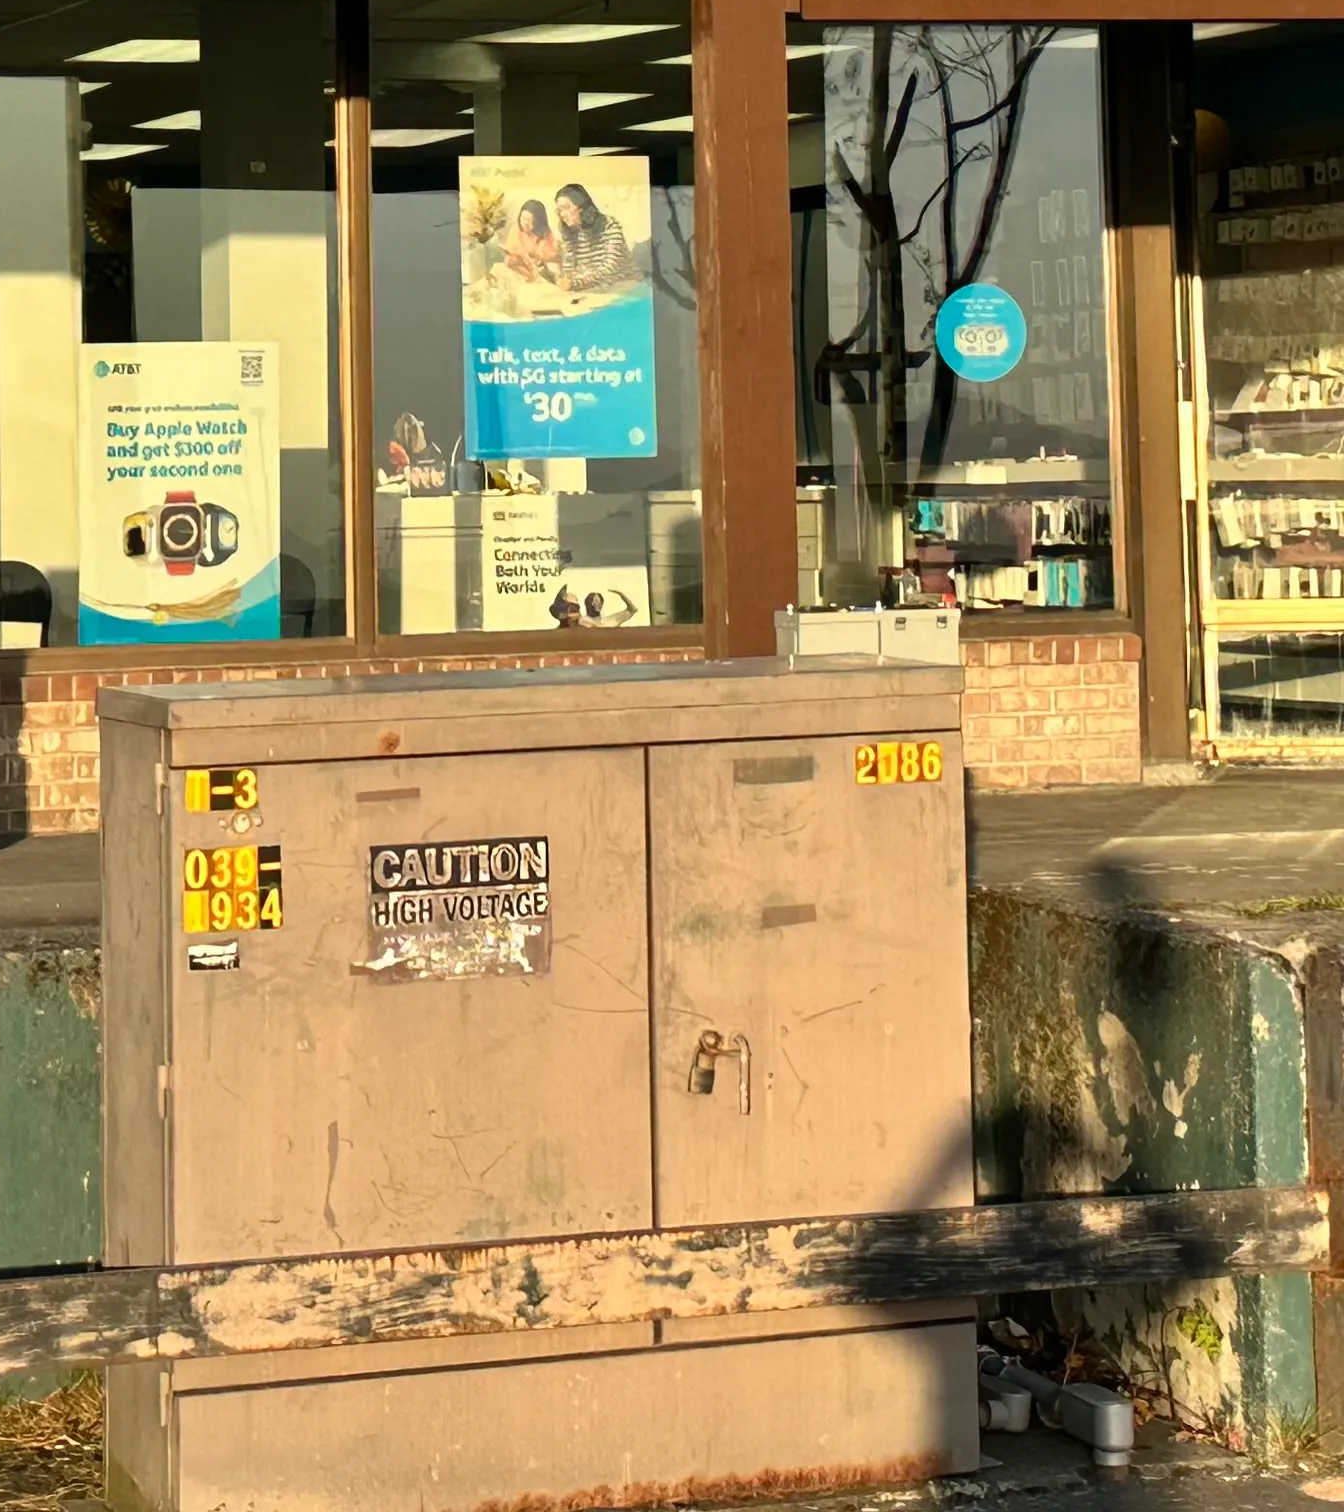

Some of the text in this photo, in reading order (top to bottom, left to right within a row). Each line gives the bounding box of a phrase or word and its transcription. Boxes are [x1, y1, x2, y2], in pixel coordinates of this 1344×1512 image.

[567, 345, 582, 363] &
[585, 344, 627, 363] data
[477, 366, 520, 385] with
[548, 367, 622, 388] starting
[624, 367, 643, 385] at
[106, 418, 248, 441] Buy Apple Watch
[106, 438, 243, 462] and get $300 off
[106, 460, 243, 482] your second one
[495, 563, 529, 578] Both
[495, 579, 547, 595] Worlds
[372, 840, 548, 890] CAUTION
[373, 891, 549, 927] HIGH VOLTAGE
